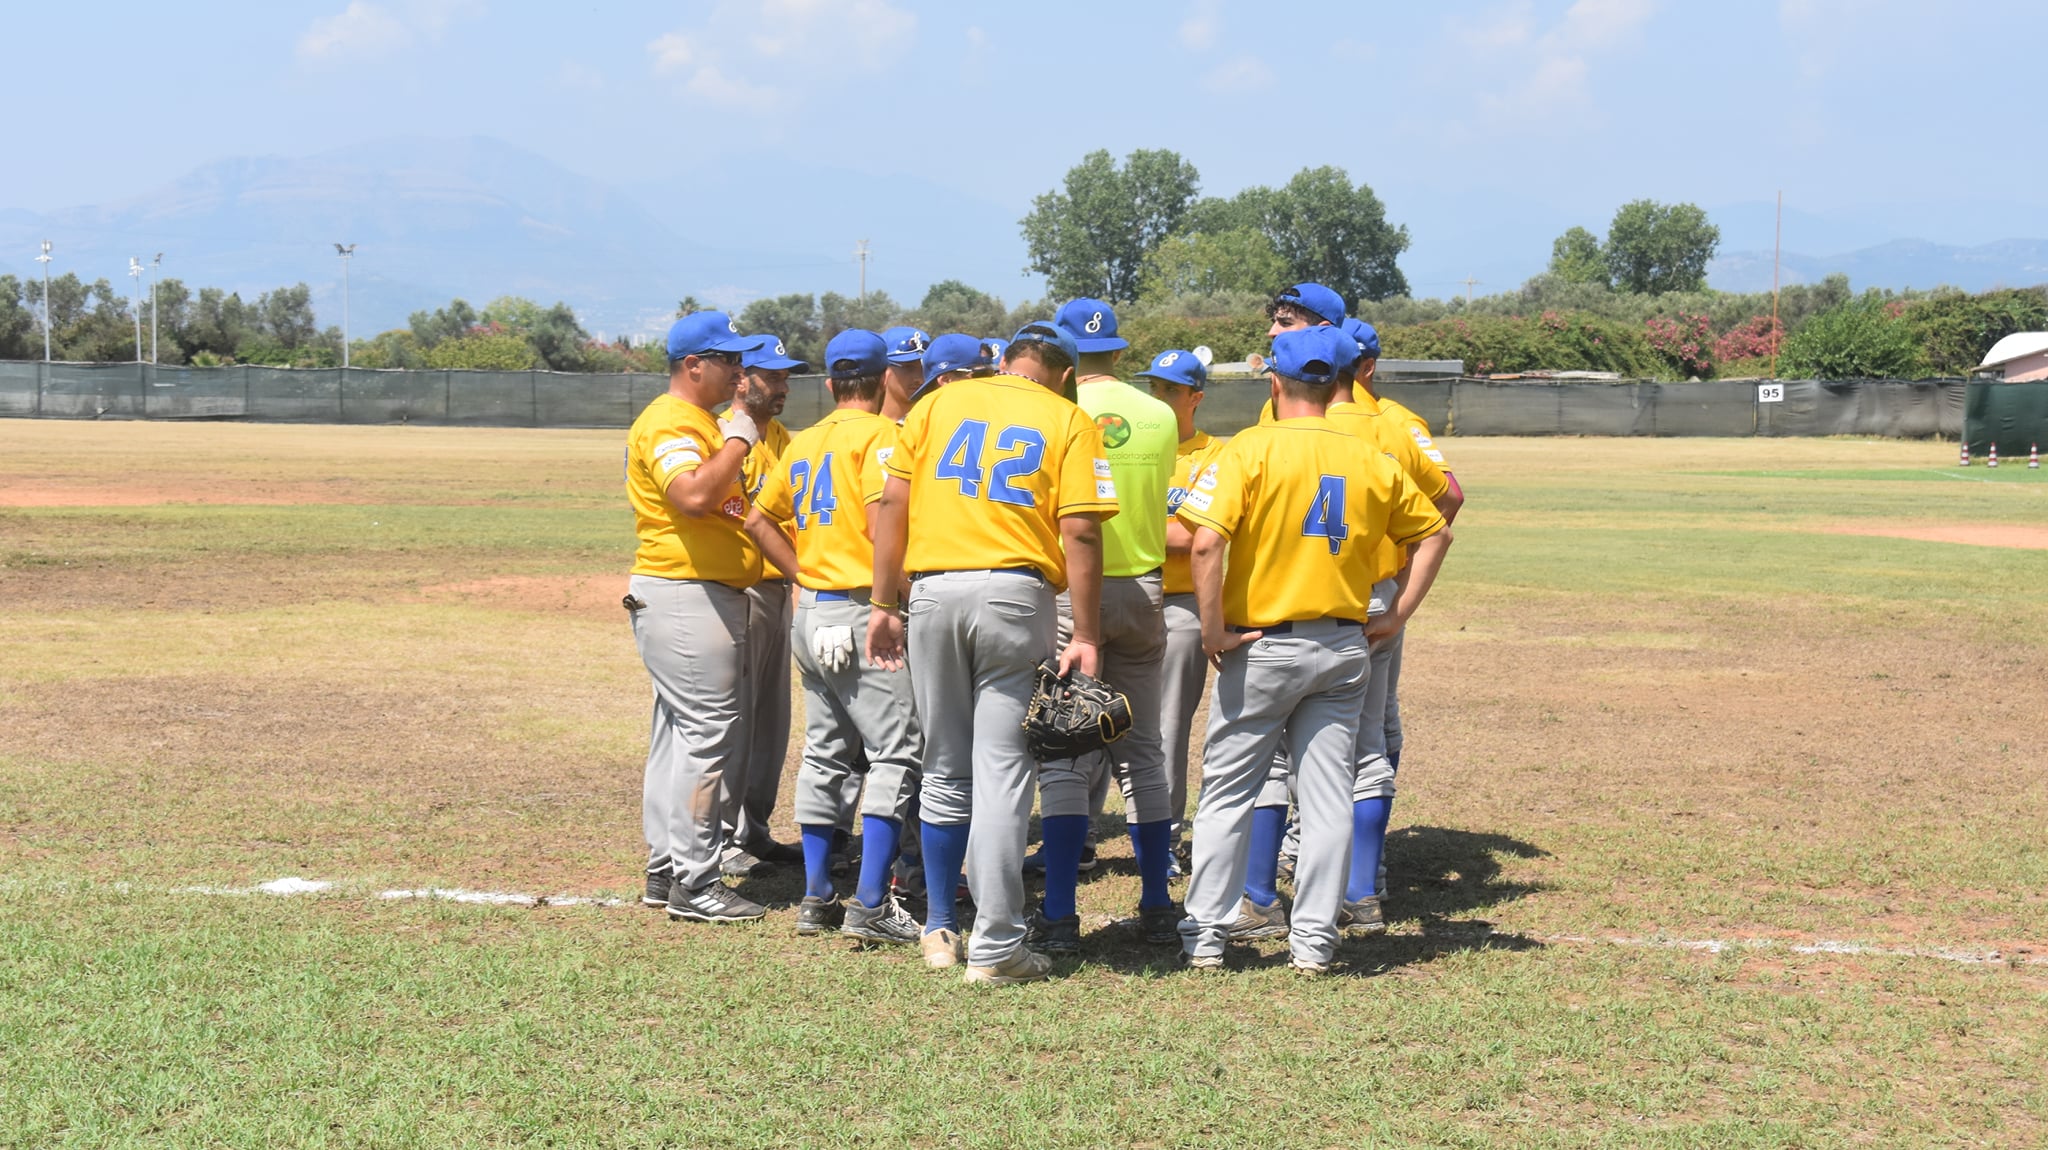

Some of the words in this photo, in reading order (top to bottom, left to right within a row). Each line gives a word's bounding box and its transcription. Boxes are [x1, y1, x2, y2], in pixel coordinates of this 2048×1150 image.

[1136, 421, 1161, 429] Color
[1762, 388, 1780, 399] 95
[789, 451, 837, 531] 24
[935, 418, 1047, 508] 42
[1301, 474, 1349, 556] 4
